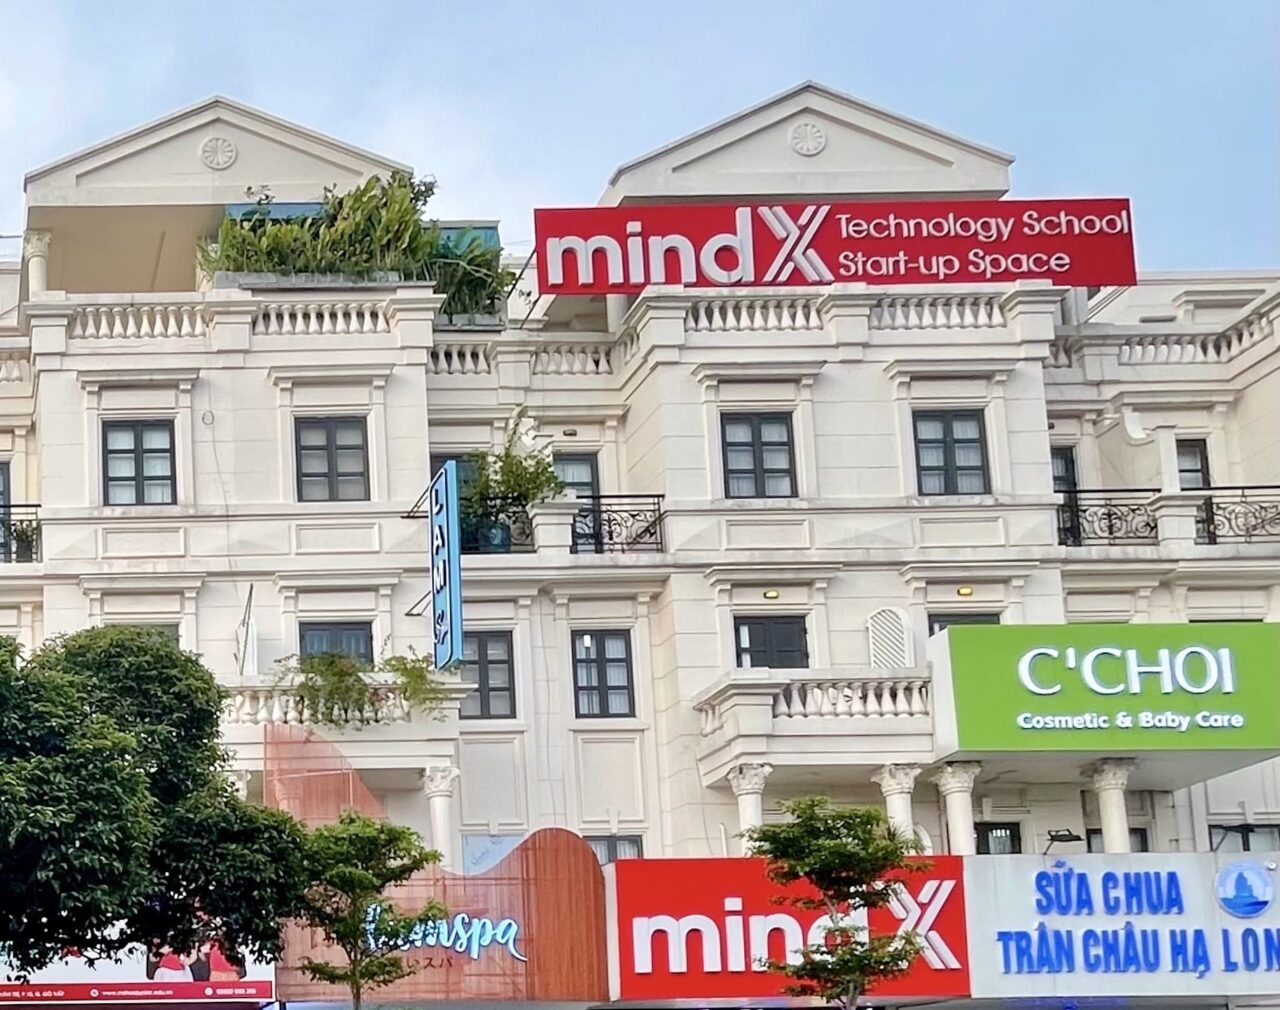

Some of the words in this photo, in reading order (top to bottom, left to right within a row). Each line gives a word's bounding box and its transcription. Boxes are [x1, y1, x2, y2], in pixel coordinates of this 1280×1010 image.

[546, 205, 835, 286] mindX
[835, 212, 1015, 242] Technology
[1022, 210, 1130, 235] School
[839, 250, 960, 280] Start-up
[968, 249, 1070, 275] Space
[1018, 646, 1234, 695] C'CHOI
[1017, 712, 1110, 728] Cosmetic
[1116, 712, 1133, 728] &
[1140, 711, 1191, 732] Baby
[1195, 711, 1244, 728] Care
[1034, 860, 1095, 916] SỮA
[1101, 871, 1185, 916] CHUA
[996, 921, 1075, 974] TRÂN
[1082, 921, 1160, 973] CHÂU
[1169, 928, 1211, 979] HẠ
